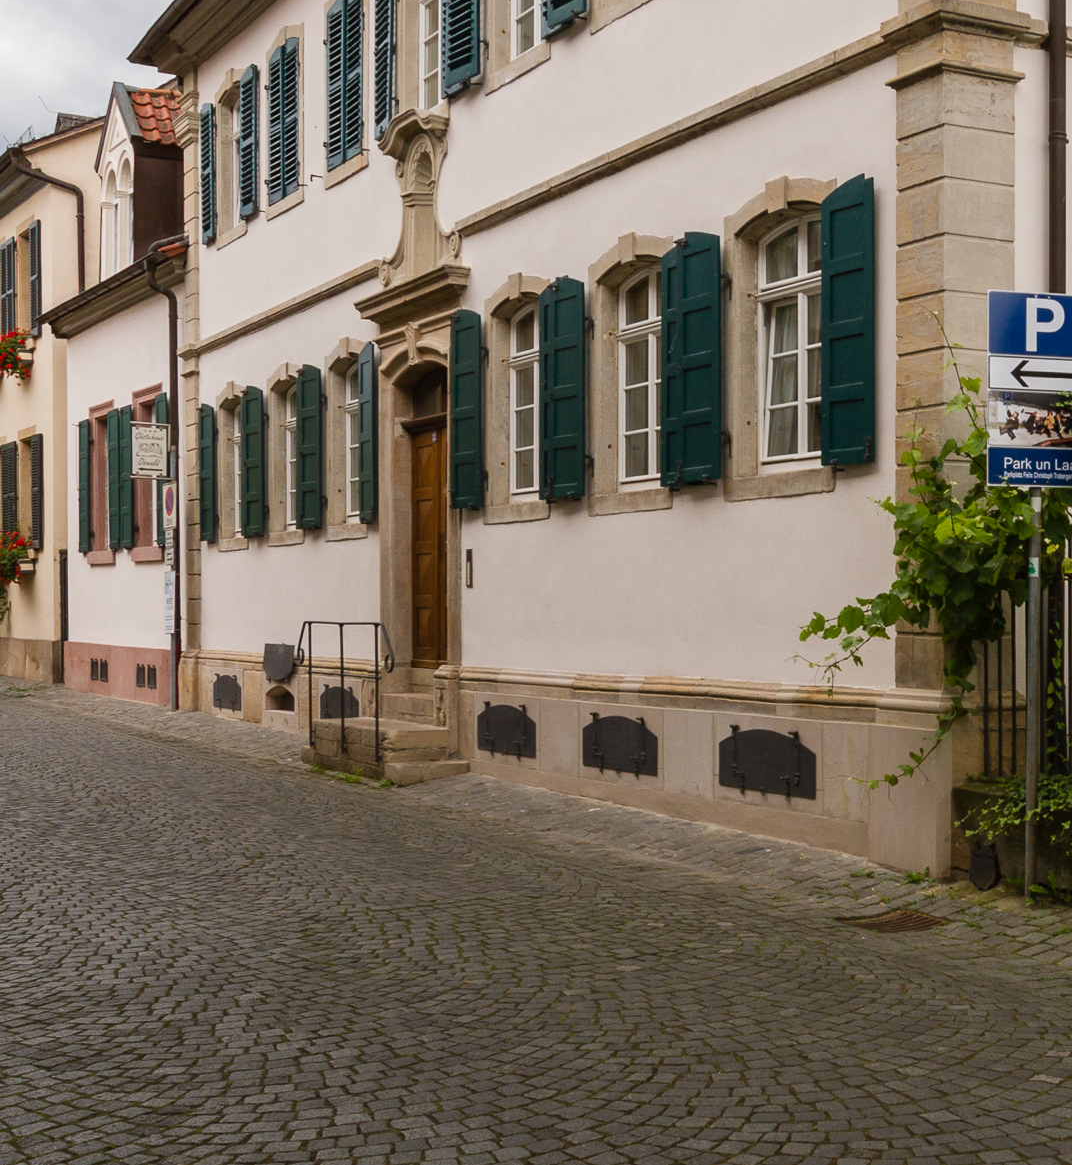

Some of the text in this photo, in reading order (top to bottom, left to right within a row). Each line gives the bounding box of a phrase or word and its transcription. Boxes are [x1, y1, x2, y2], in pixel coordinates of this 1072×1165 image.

[1026, 298, 1065, 352] P
[1004, 457, 1032, 469] Park
[1035, 460, 1051, 470] un
[1004, 471, 1022, 479] Parkplatz
